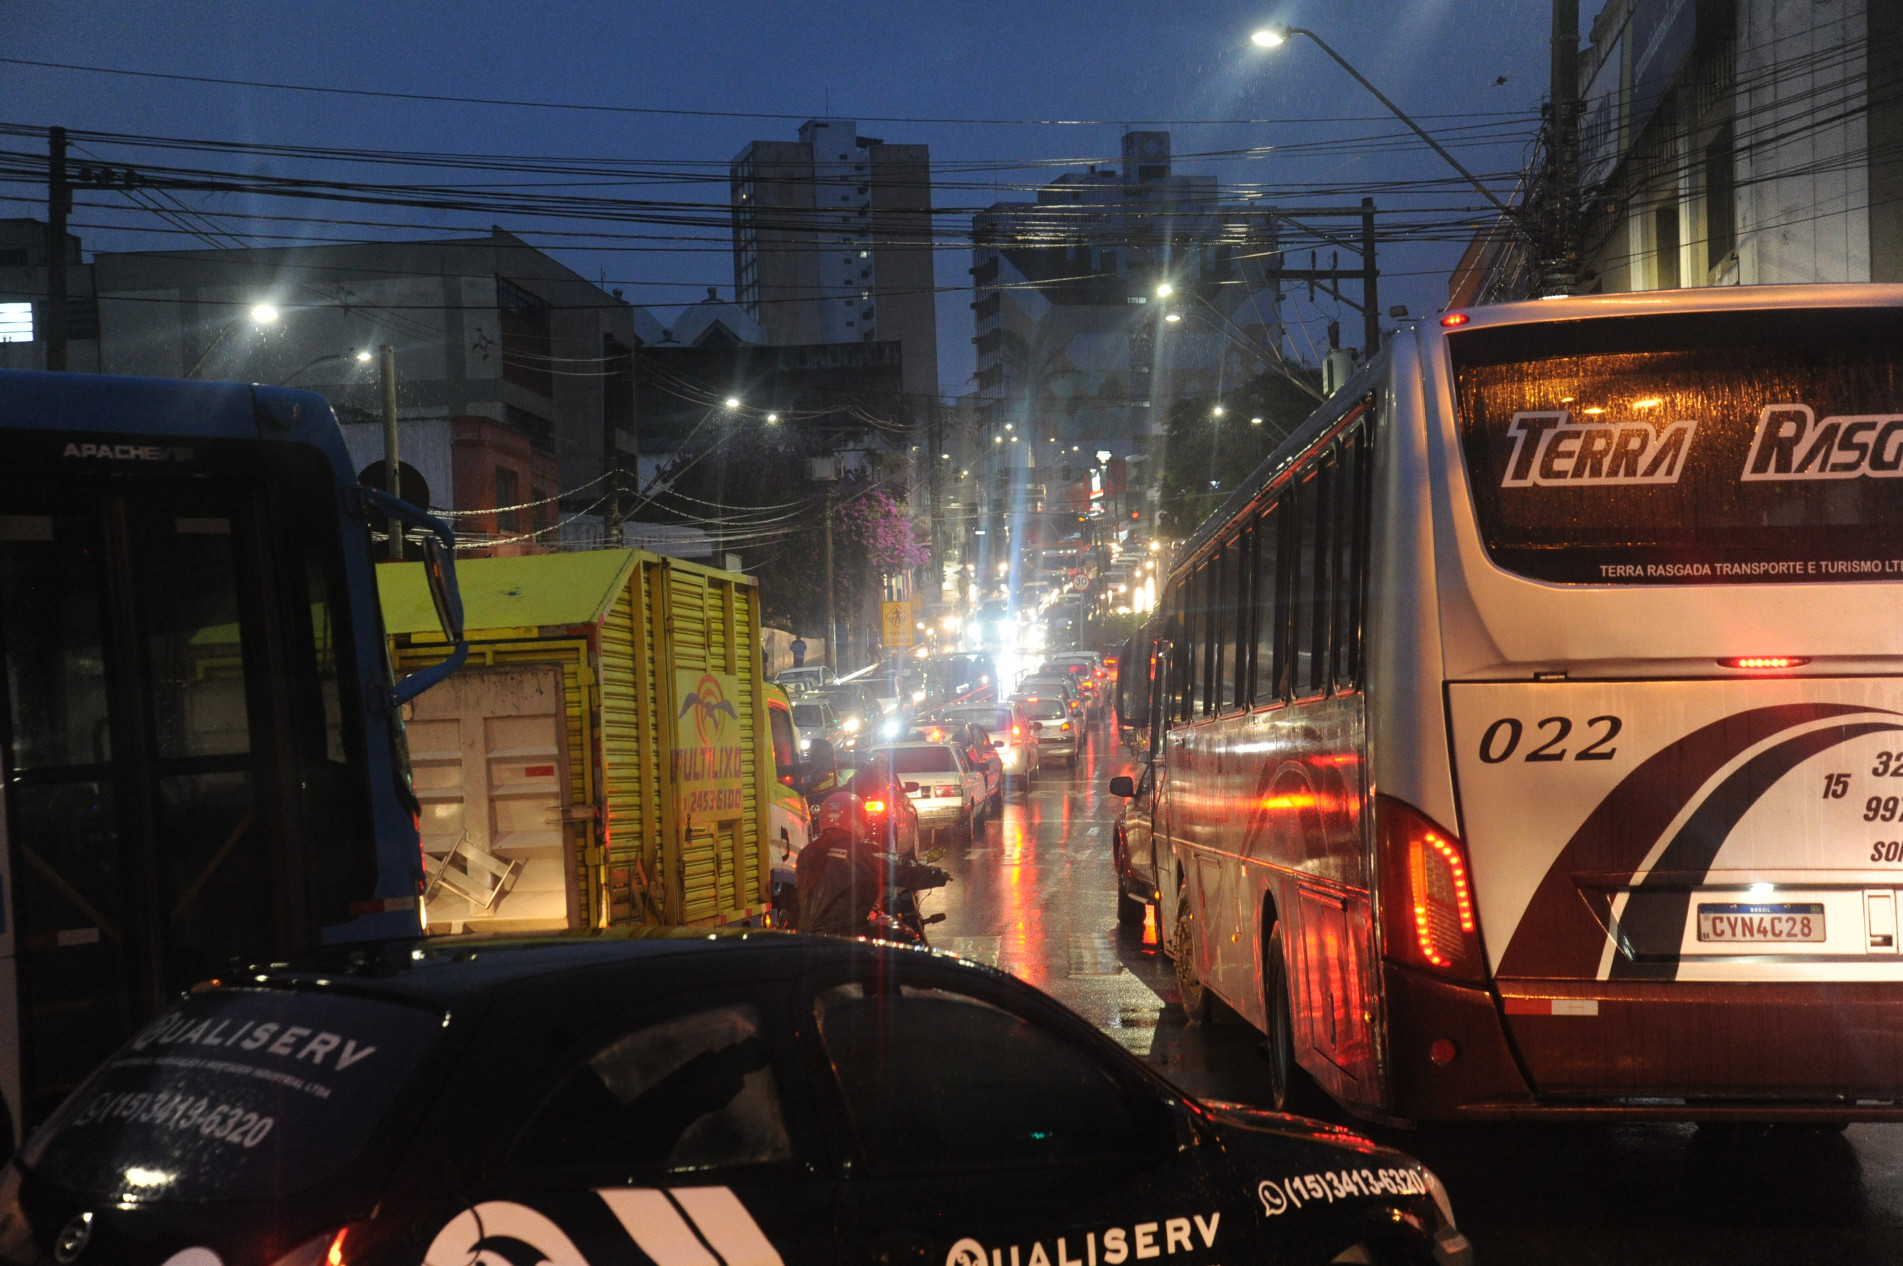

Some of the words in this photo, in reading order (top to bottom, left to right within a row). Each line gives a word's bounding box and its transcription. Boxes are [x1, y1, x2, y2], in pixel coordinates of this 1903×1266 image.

[62, 442, 161, 460] APACHE
[1502, 411, 1698, 488] TERRA
[1075, 577, 1087, 586] 30
[1600, 564, 1644, 577] TERRA
[1647, 563, 1711, 576] RASGADA
[1714, 562, 1804, 575] TRANSPORTE
[1807, 561, 1817, 574] E
[1819, 560, 1882, 573] TURISMO
[1885, 560, 1903, 572] LT
[1479, 715, 1622, 764] 022
[1822, 773, 1852, 799] 15
[1870, 840, 1903, 862] SO
[1712, 916, 1812, 938] CYN4C28
[132, 1011, 377, 1072] QUALISERV
[1284, 1168, 1426, 1208] (15)3413-6320
[945, 1212, 1220, 1266] QUALISERV
